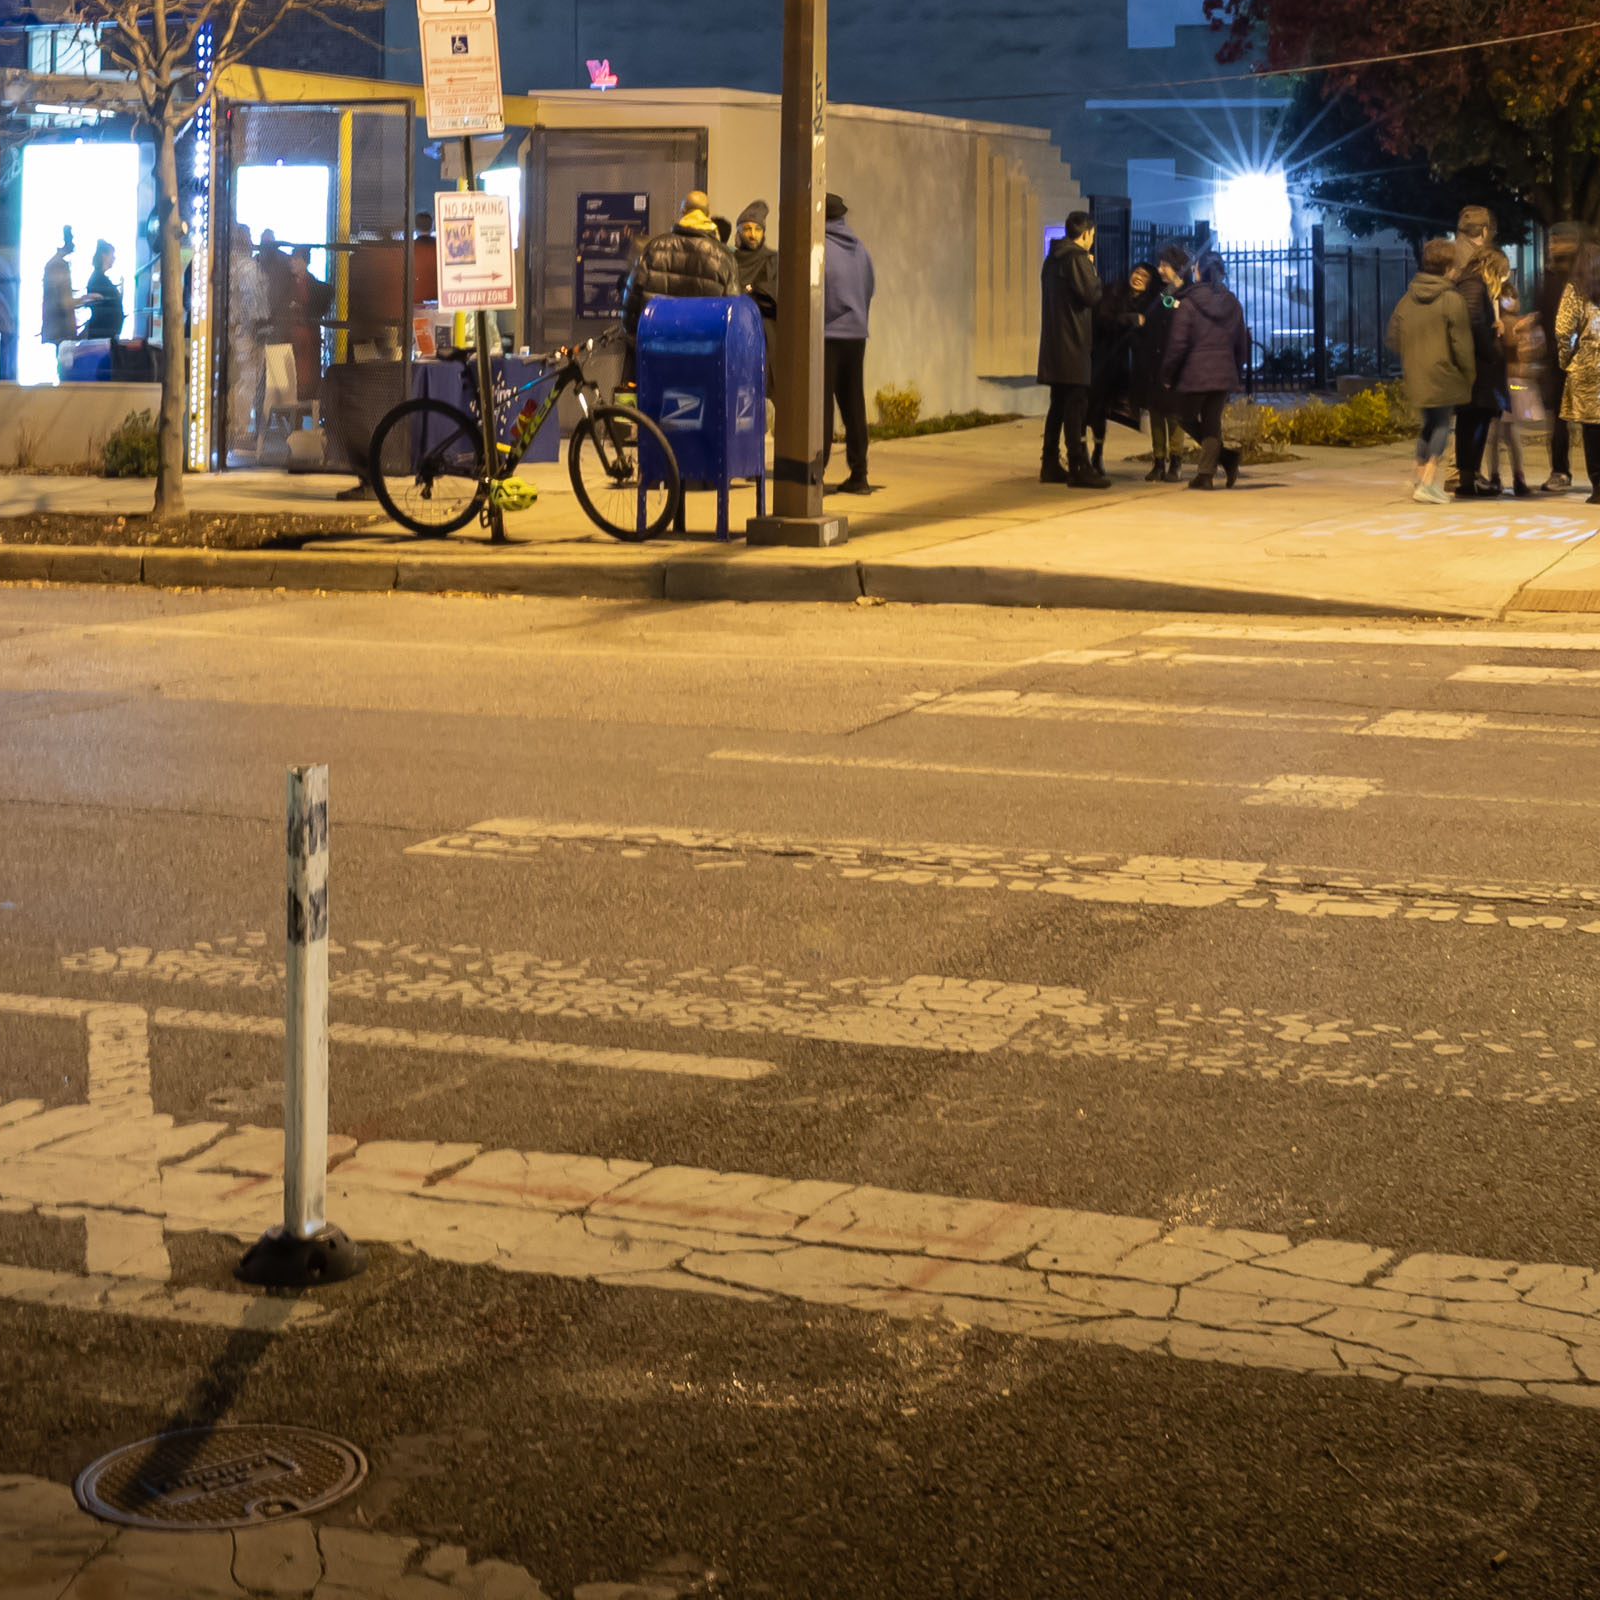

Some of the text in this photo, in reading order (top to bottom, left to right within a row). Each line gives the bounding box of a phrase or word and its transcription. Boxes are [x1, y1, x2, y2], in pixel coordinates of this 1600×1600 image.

[444, 200, 504, 217] NO PARKING
[447, 289, 509, 305] TOW AWAY ZONE
